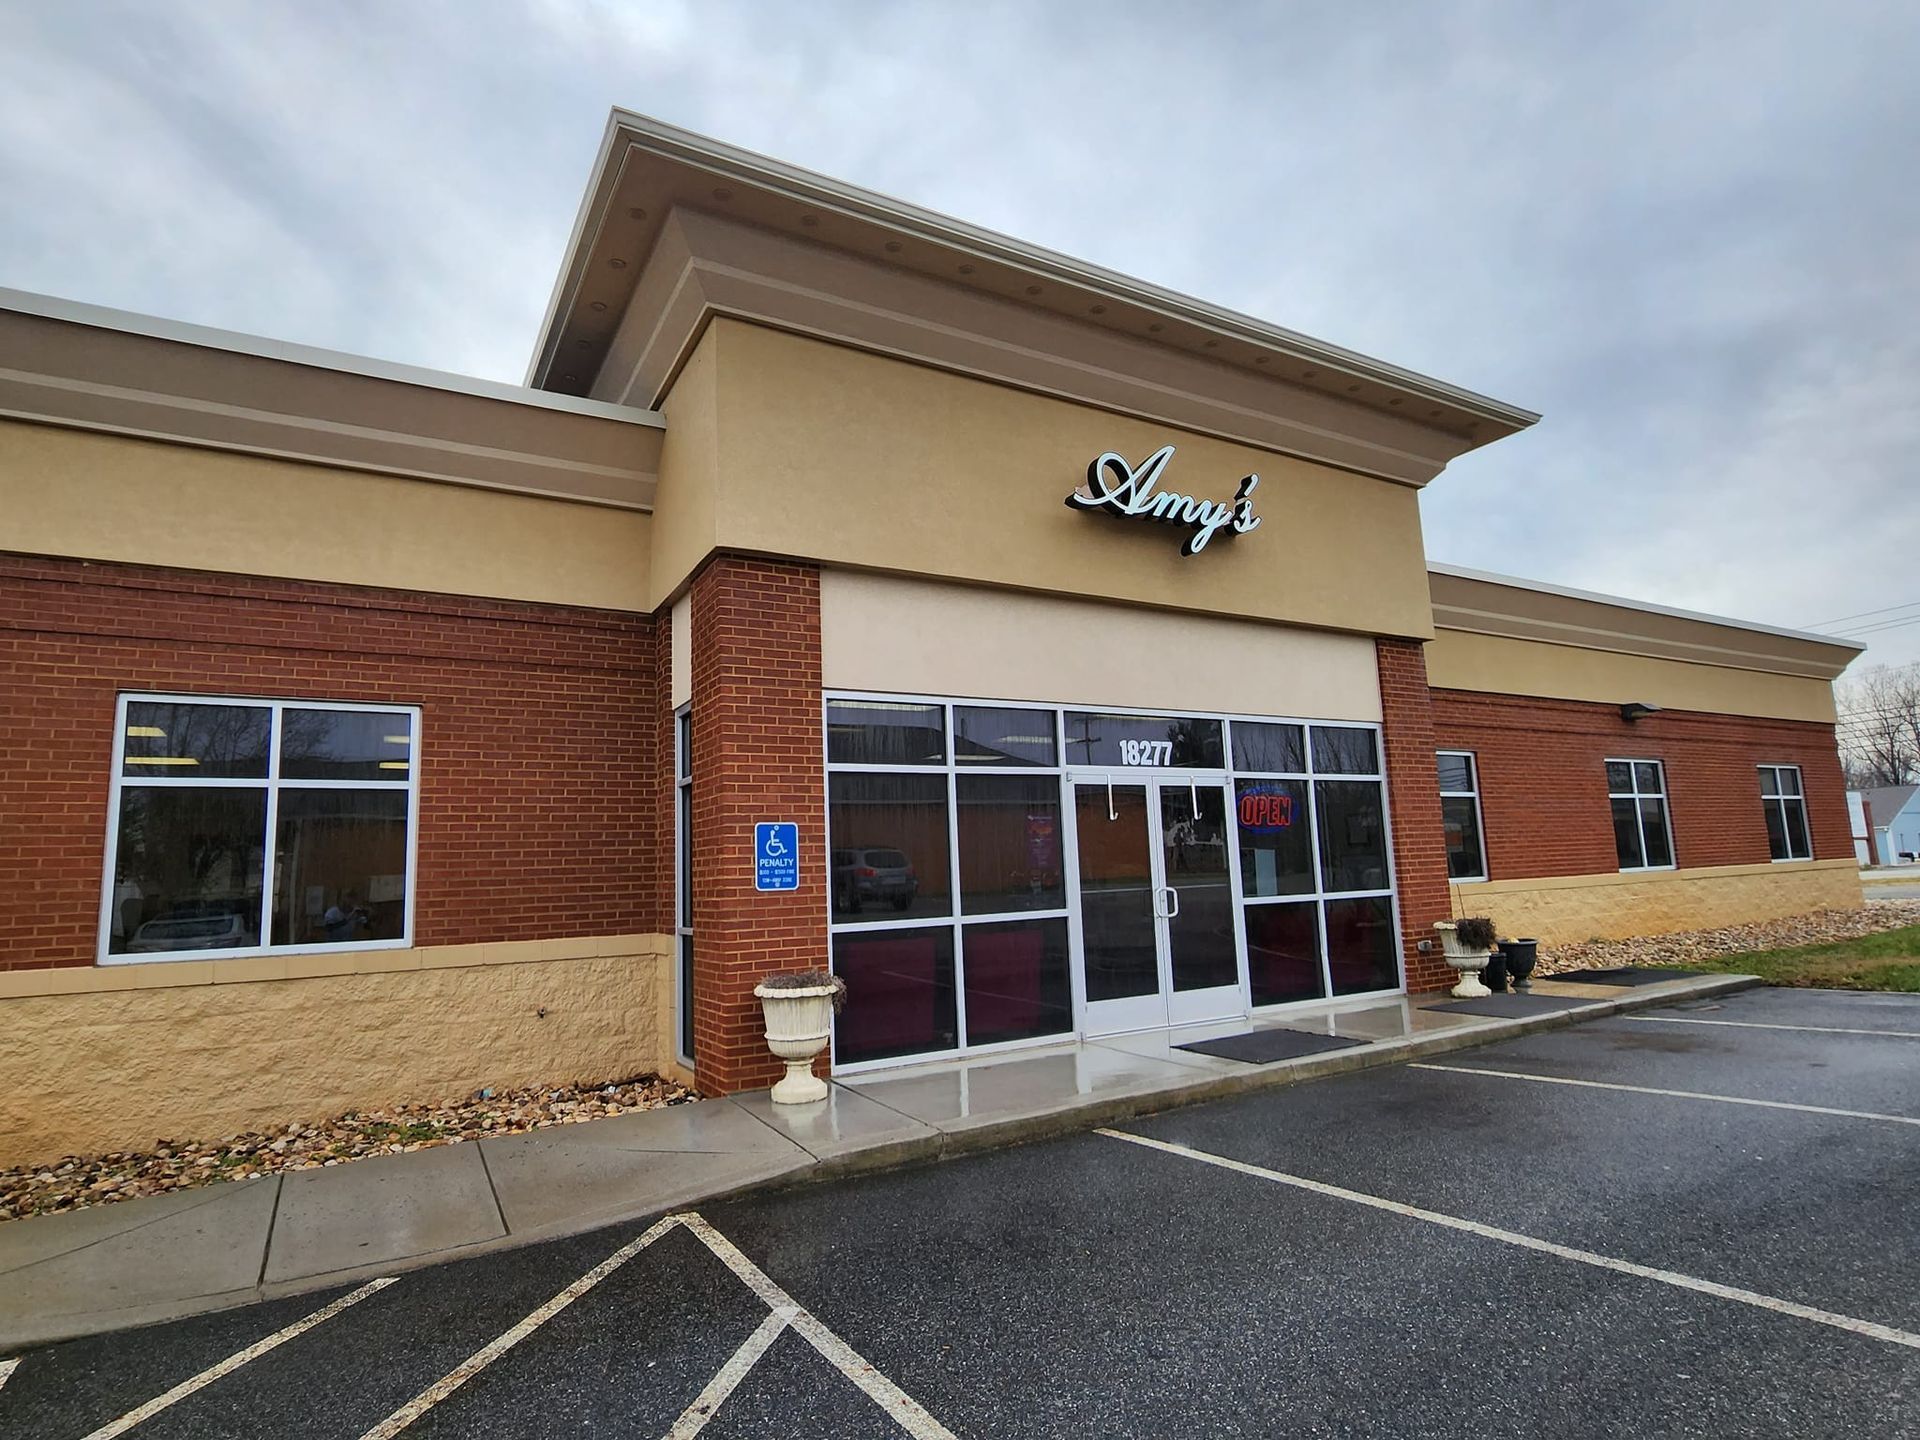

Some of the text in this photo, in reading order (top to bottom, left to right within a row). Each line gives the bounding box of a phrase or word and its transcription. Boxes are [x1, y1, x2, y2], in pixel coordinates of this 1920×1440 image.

[1067, 445, 1262, 556] Amy's
[1119, 739, 1173, 766] 18277
[1240, 796, 1292, 826] OPEN
[759, 858, 794, 867] PENALTY
